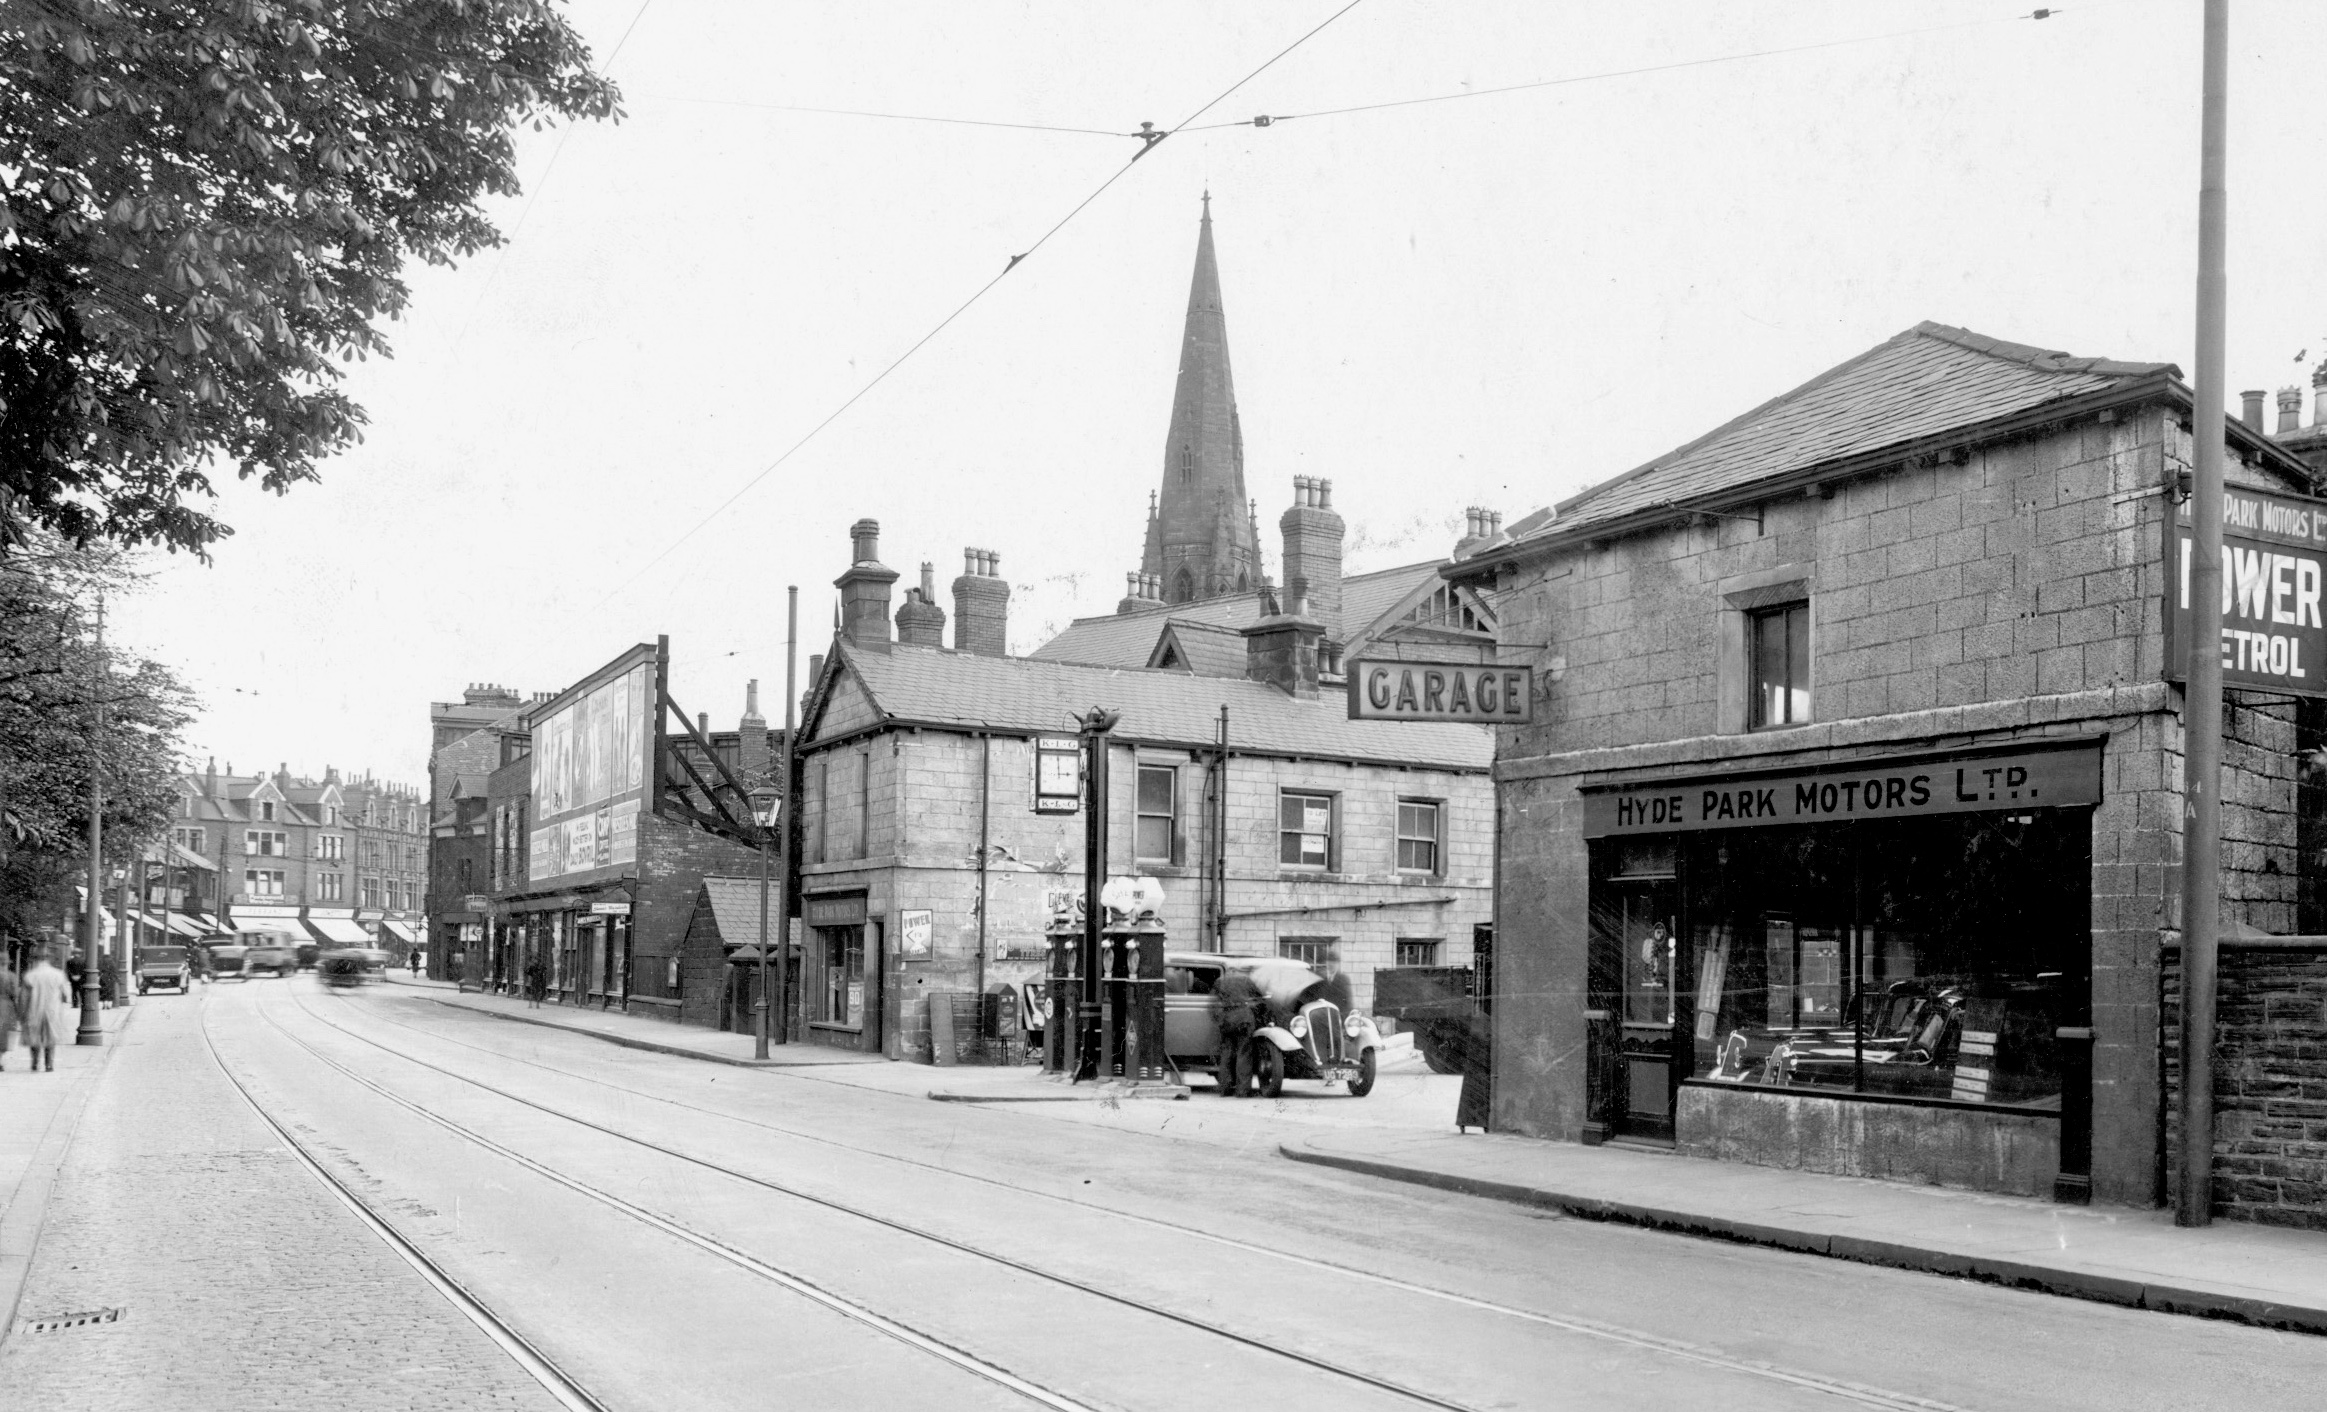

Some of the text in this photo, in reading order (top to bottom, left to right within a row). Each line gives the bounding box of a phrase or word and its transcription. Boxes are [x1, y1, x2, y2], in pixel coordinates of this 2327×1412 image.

[2224, 493, 2258, 529] PARK
[2262, 500, 2309, 538] MOTORS
[2222, 628, 2306, 678] ETROL
[1368, 667, 1522, 715] GARAGE
[1617, 795, 1684, 827] HYDE
[1702, 788, 1777, 821] PARK
[1795, 774, 1931, 816] MOTORS
[903, 914, 931, 929] POWER
